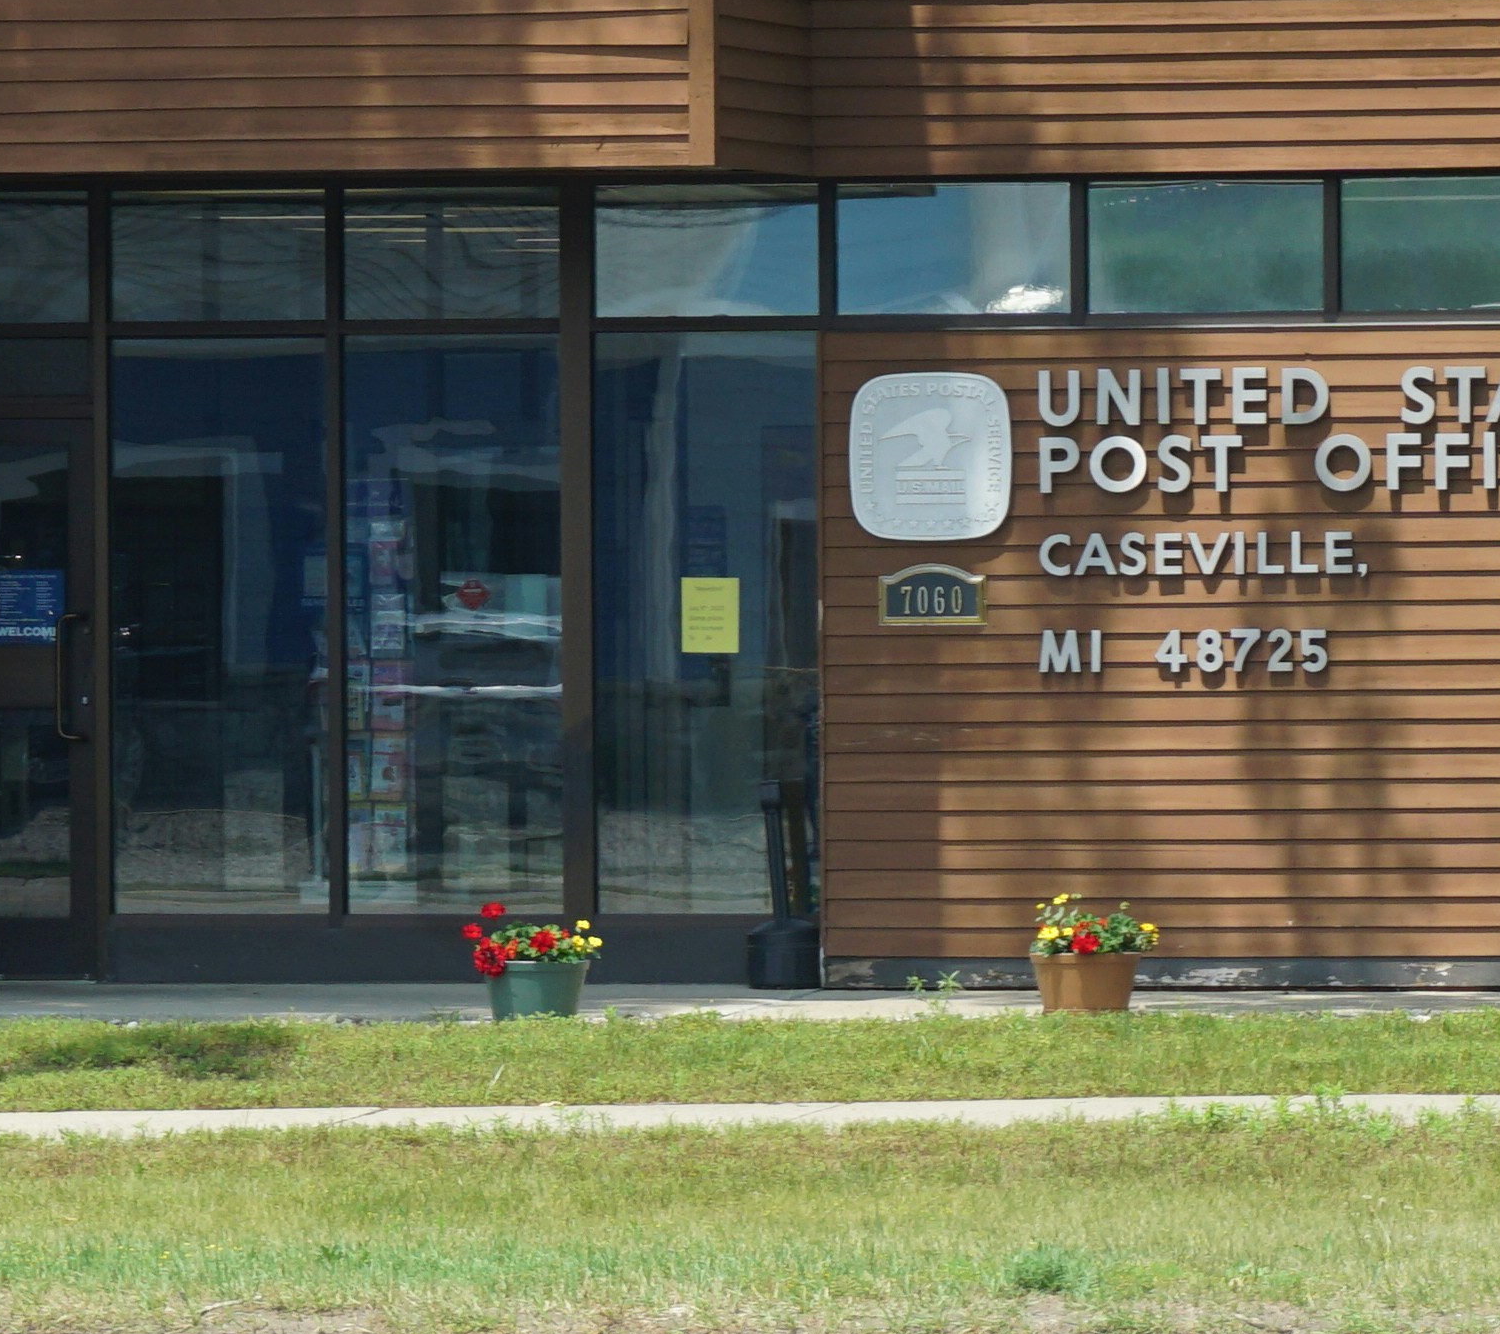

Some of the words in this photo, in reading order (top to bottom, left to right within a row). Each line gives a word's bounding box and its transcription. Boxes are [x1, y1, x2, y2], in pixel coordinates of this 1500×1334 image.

[861, 382, 921, 415] STATES
[926, 381, 997, 412] POSTAL
[1038, 366, 1330, 427] UNITED
[859, 421, 873, 495] UNITED
[986, 417, 1003, 493] SERVICE
[1038, 434, 1244, 494] POST
[1038, 531, 1368, 579] CASEVILLE,
[900, 585, 963, 615] 7060
[1038, 629, 1102, 674] MI
[1153, 627, 1329, 673] 48725
